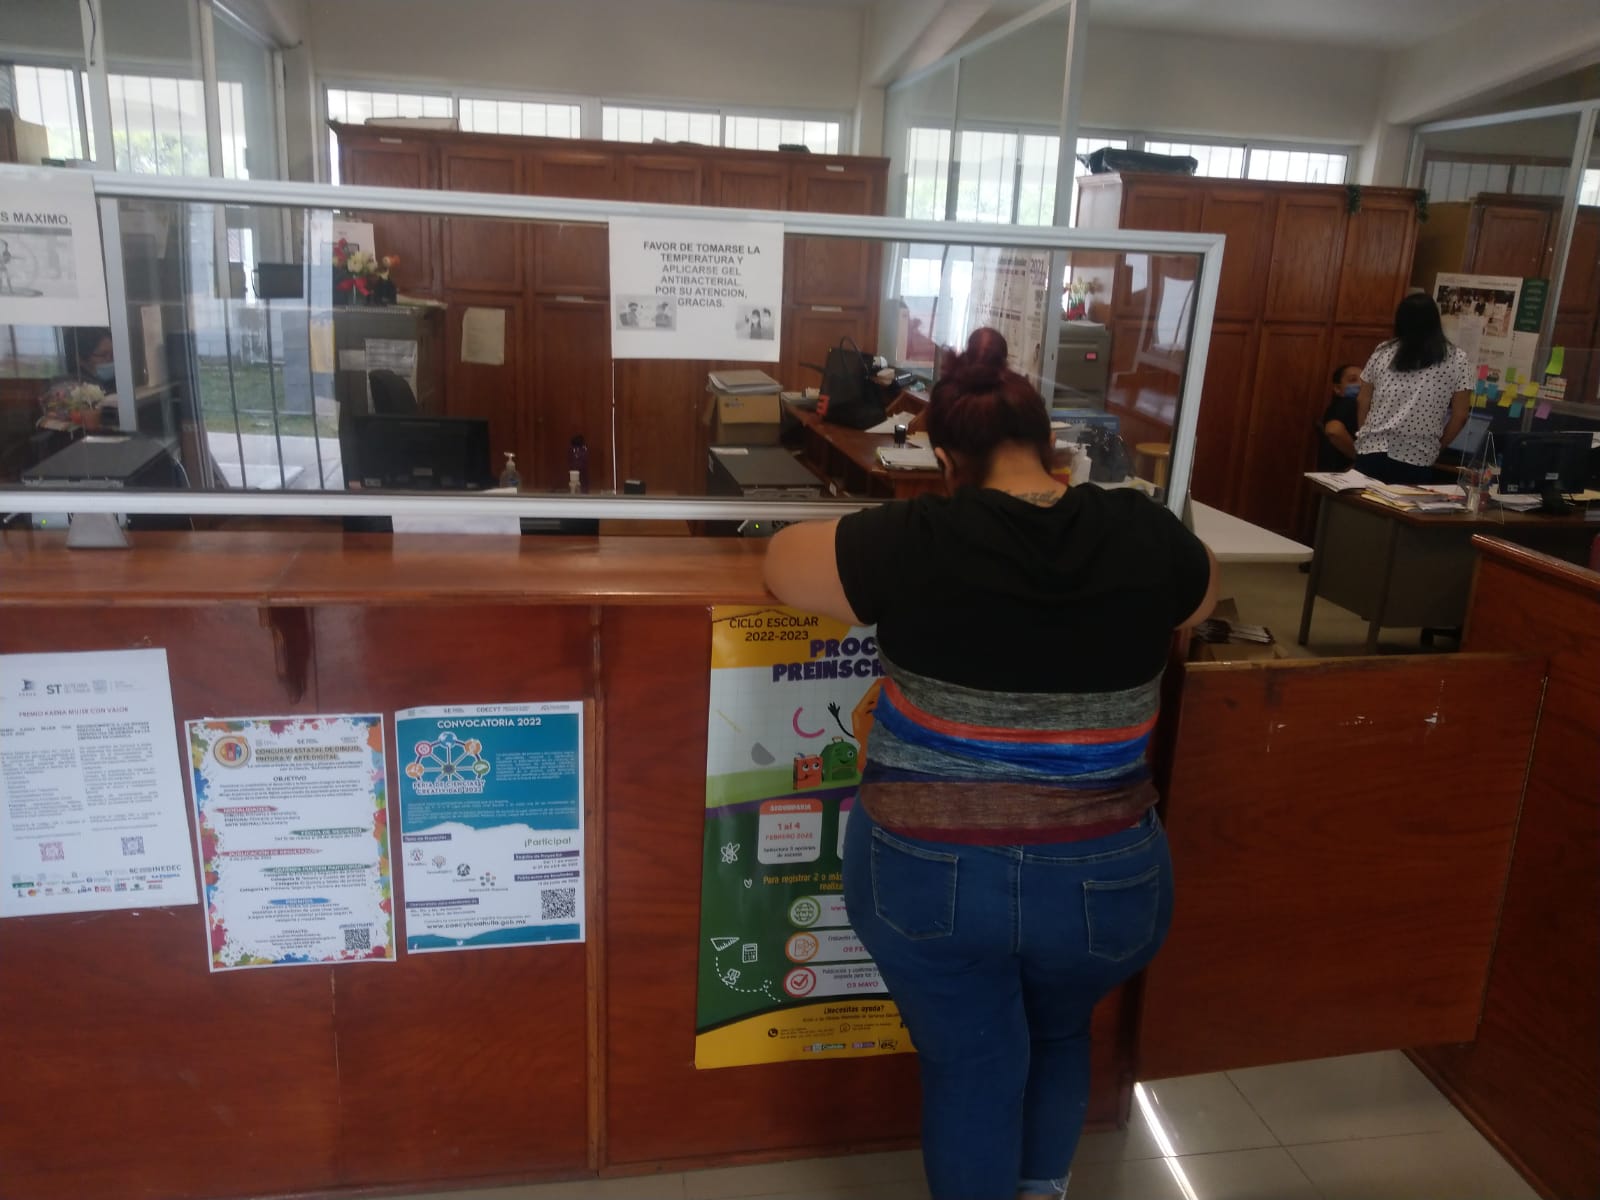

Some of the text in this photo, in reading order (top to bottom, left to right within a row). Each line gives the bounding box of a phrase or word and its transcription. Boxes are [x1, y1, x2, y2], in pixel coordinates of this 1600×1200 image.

[13, 212, 72, 225] MAXIMO.
[643, 241, 760, 254] FAVOR DE TOMARSE LA
[660, 253, 744, 265] TEMPERATURA Y
[662, 265, 718, 275] APLICARSE
[655, 286, 676, 295] POR
[679, 287, 692, 296] SU
[730, 616, 819, 628] CICLO ESCOLAR
[745, 631, 809, 642] 2022-2023
[437, 718, 542, 729] CONVOCATORIA 2022
[255, 747, 294, 755] CONCURSO
[294, 746, 323, 754] ESTATAL
[770, 803, 811, 812] SECUNDARIA
[784, 822, 793, 830] al
[794, 821, 801, 829] 4
[765, 833, 795, 841] FEBRERO
[763, 875, 779, 885] Para
[782, 873, 811, 885] registrar
[861, 1005, 884, 1014] ayuda?
